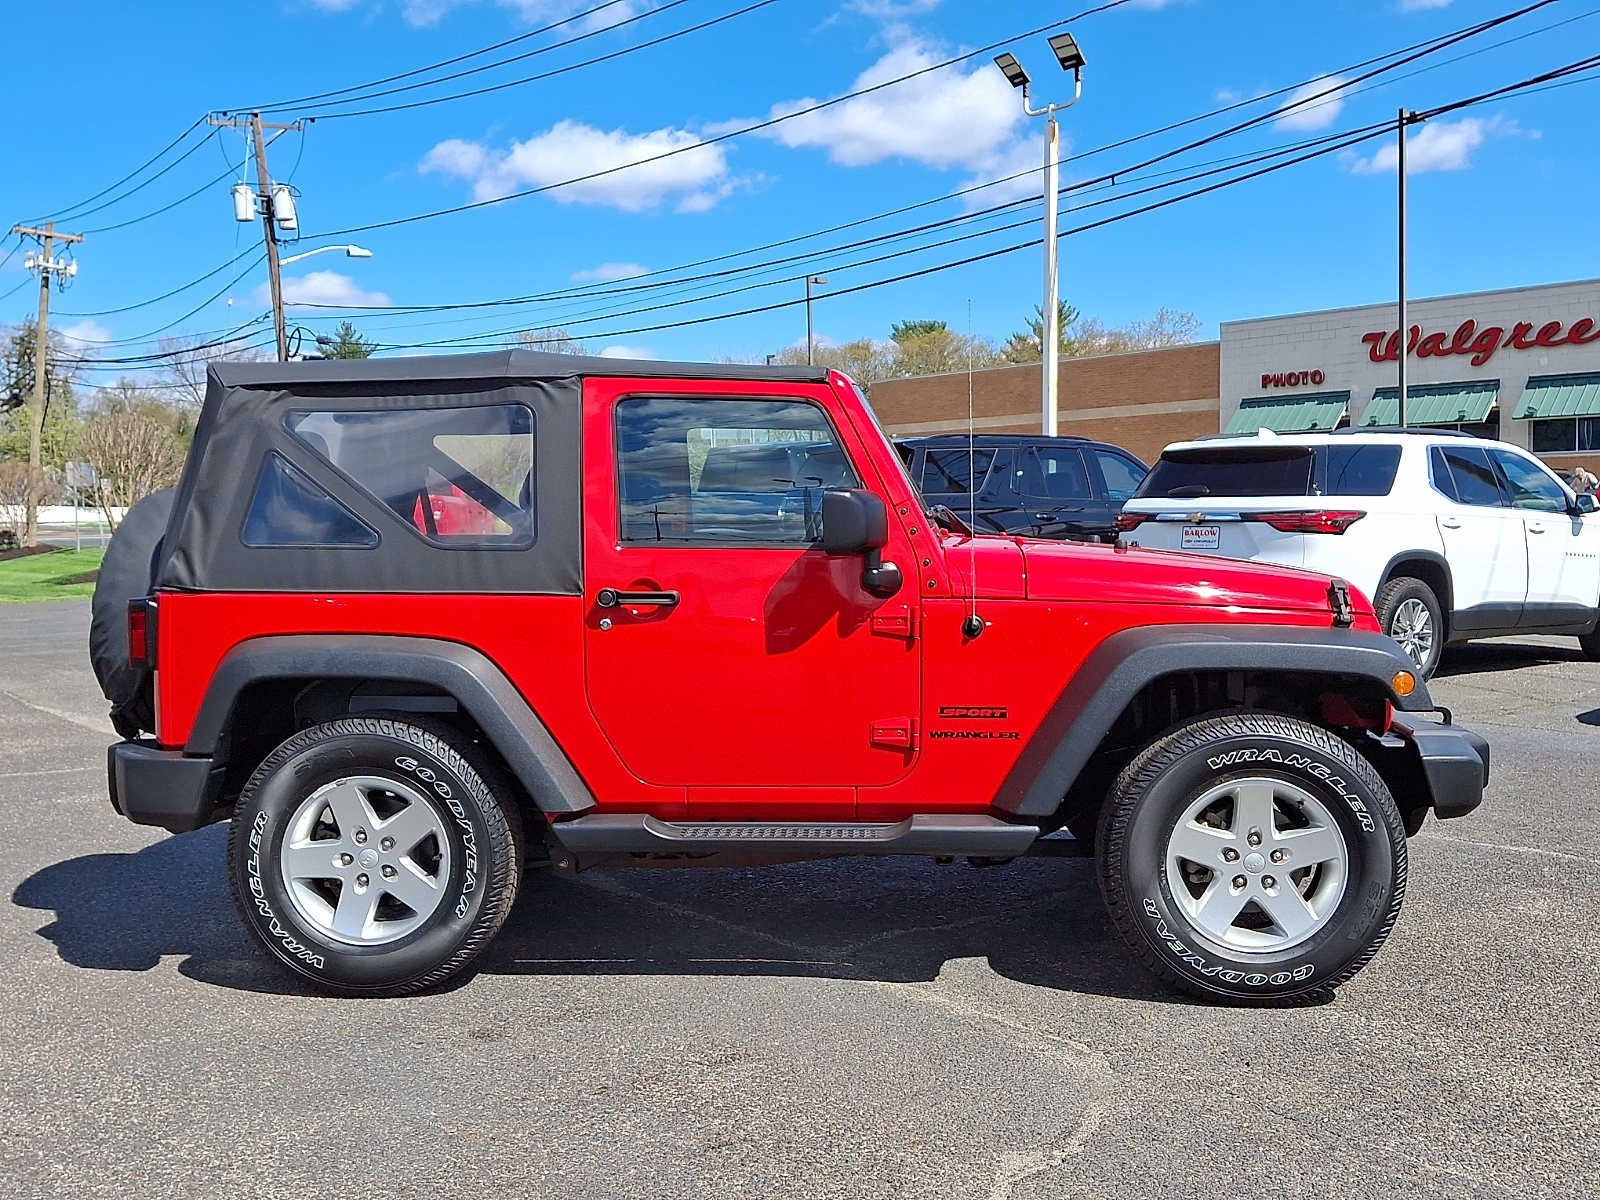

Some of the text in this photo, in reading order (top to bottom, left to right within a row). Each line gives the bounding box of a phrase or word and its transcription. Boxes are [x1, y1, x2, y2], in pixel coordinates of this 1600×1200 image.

[1261, 369, 1325, 388] PHOTO
[1184, 529, 1217, 538] BARLOW
[941, 707, 1003, 718] SPORT
[1207, 749, 1375, 833] WRANGLER
[395, 756, 478, 919] GOODYEAR
[247, 811, 324, 968] WRANGLER
[1143, 898, 1315, 985] GOODYEAR
